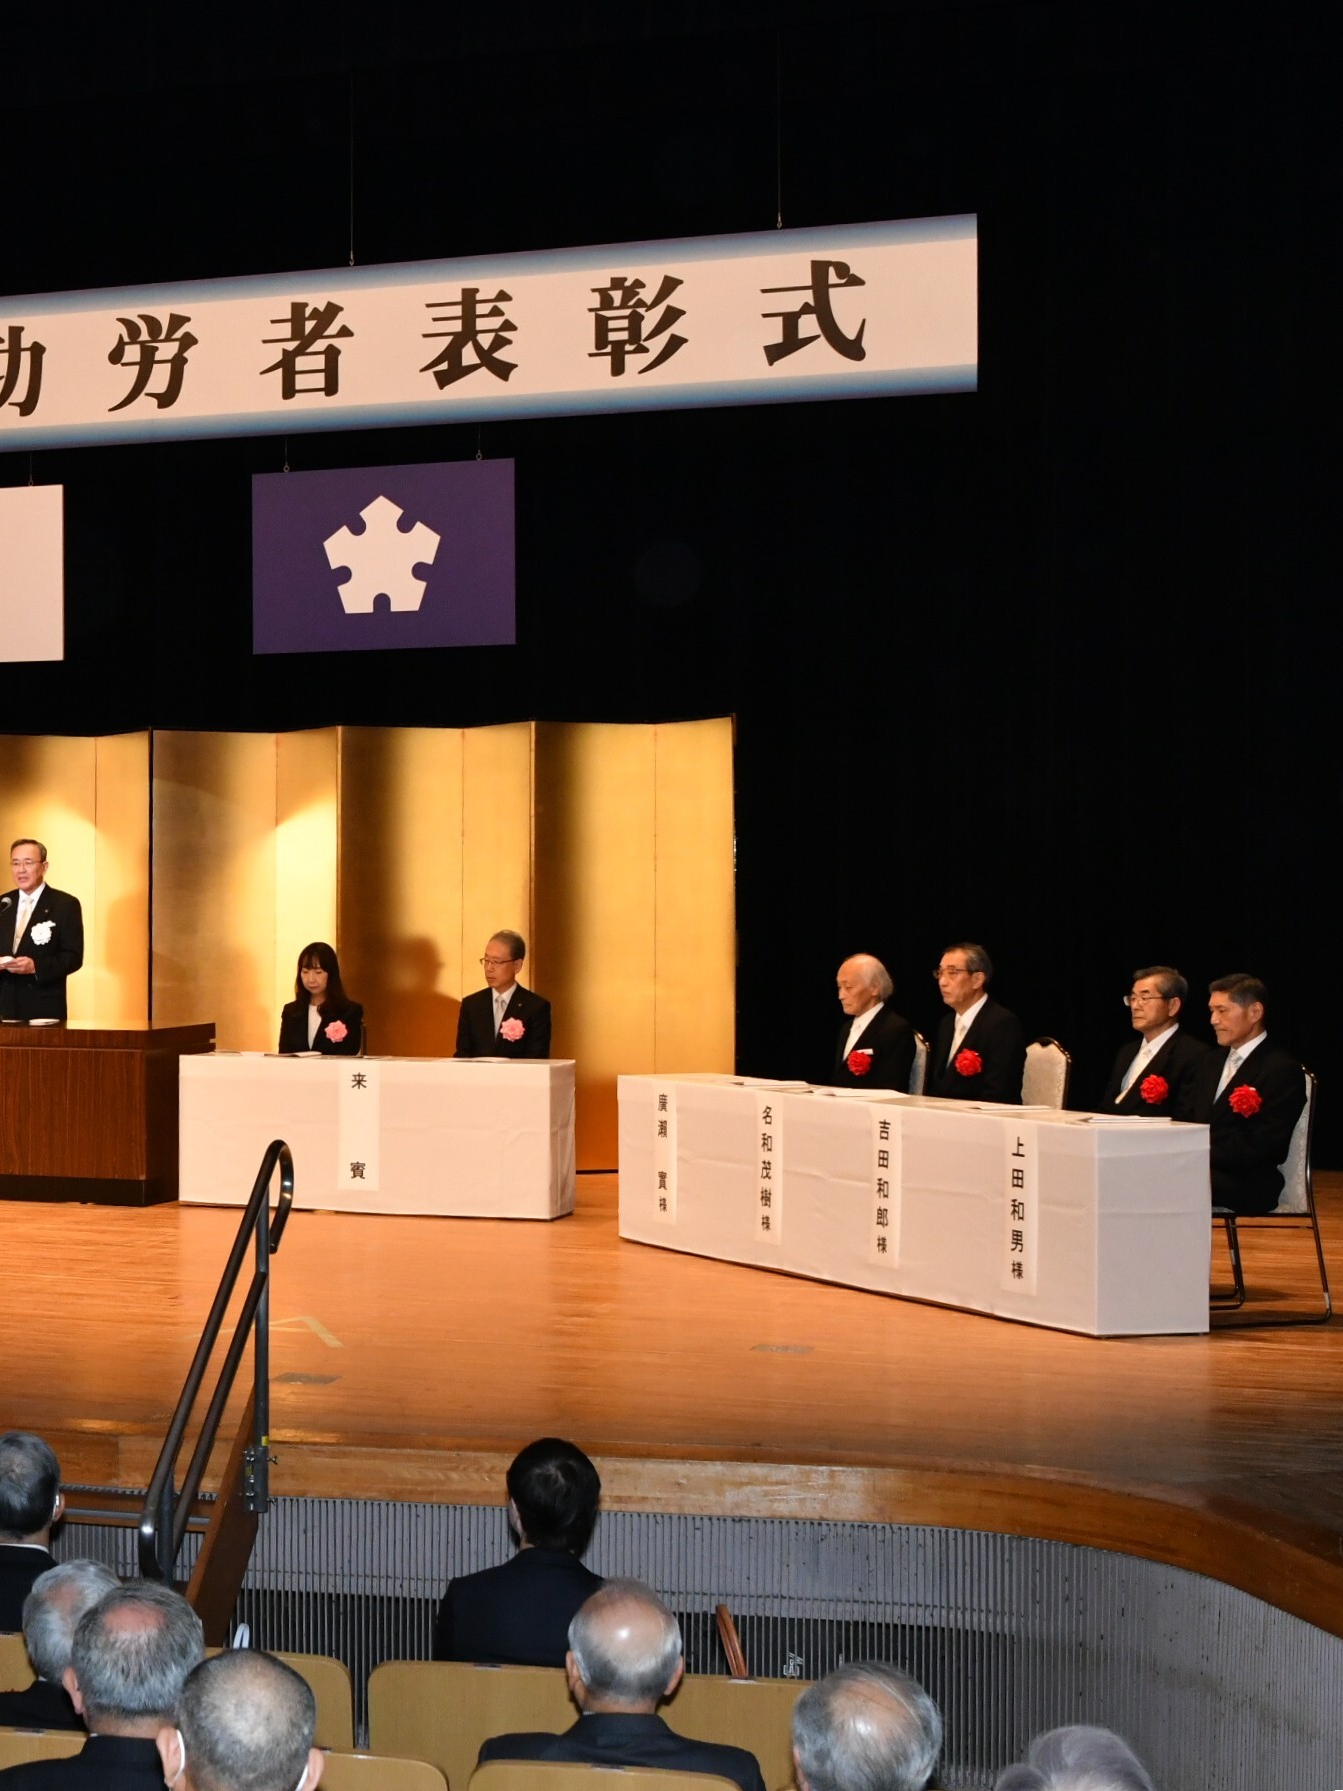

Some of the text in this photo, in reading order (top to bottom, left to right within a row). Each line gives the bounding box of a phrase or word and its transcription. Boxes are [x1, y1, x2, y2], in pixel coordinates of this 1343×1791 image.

[349, 1072, 368, 1180] 来賓
[759, 1104, 773, 1232] 名和茂樹様
[875, 1119, 892, 1255] 吉田和郎様
[1010, 1136, 1027, 1280] 上田和男様
